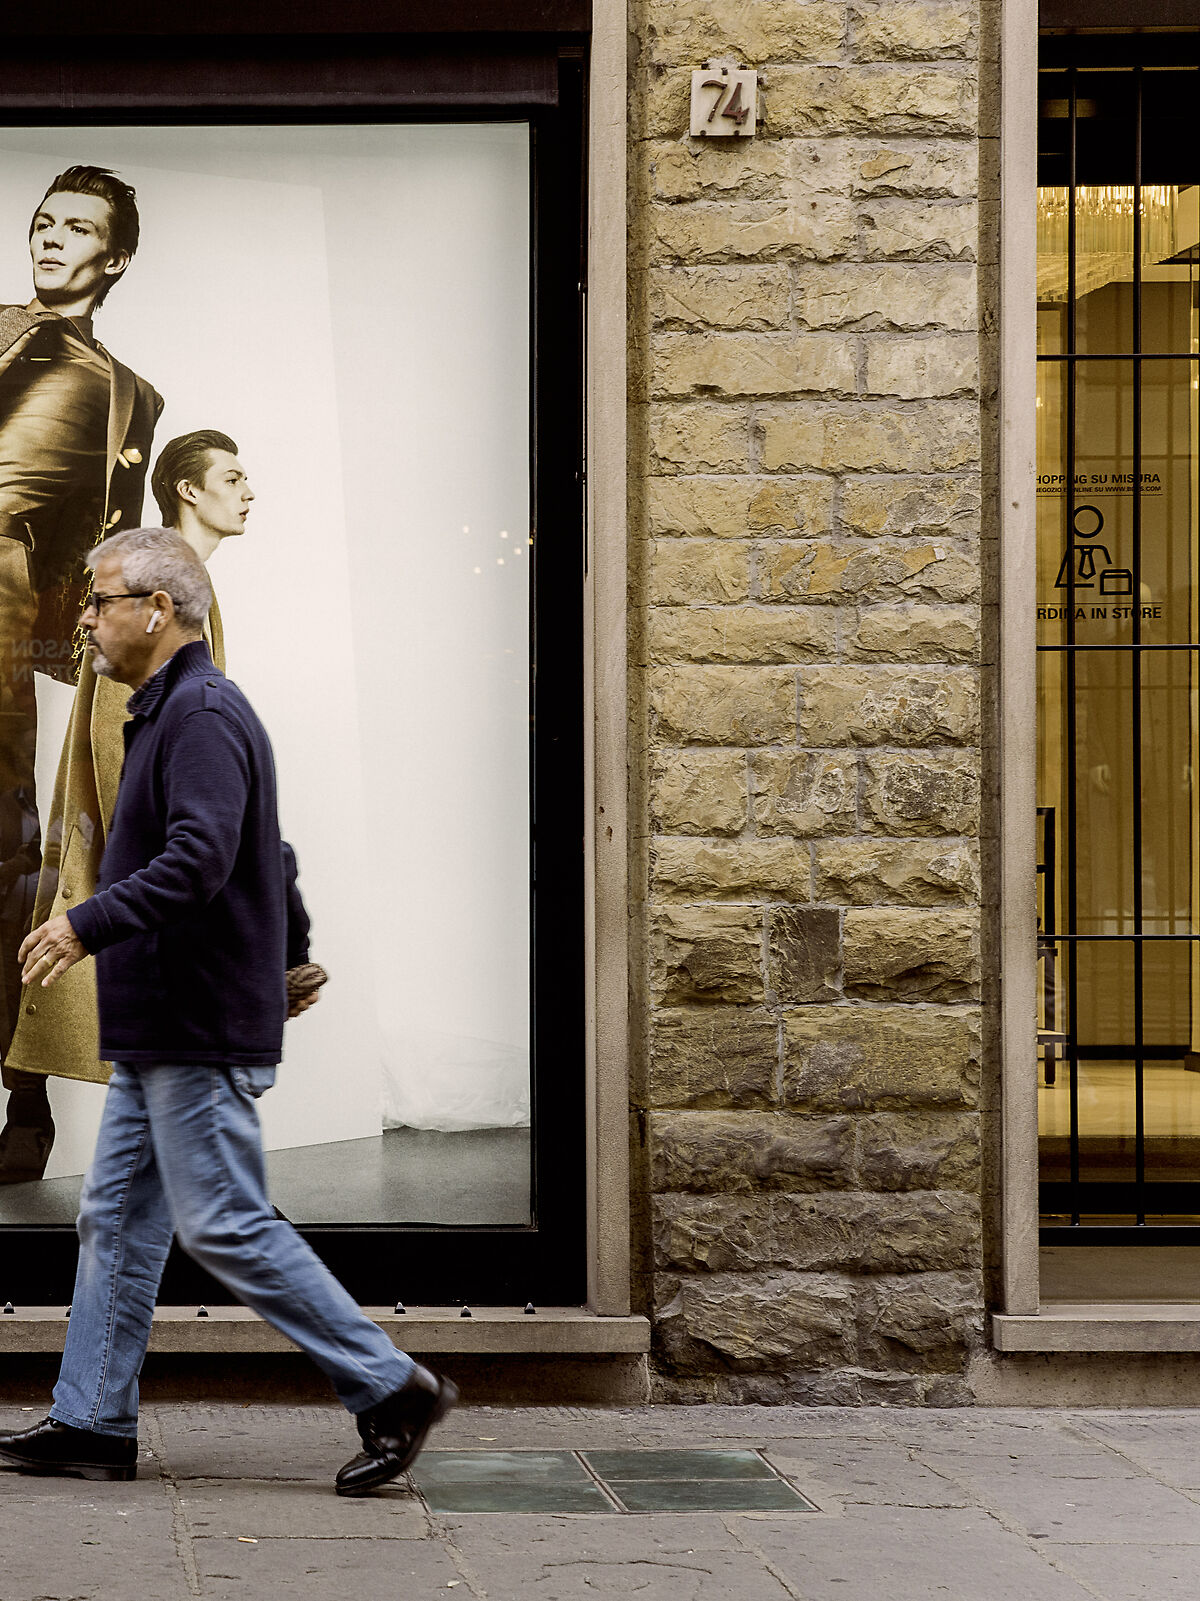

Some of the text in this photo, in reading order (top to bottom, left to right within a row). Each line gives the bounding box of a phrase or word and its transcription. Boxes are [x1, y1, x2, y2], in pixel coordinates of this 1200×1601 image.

[701, 80, 750, 125] 74
[1091, 474, 1108, 484] SU
[1091, 607, 1107, 619] IN
